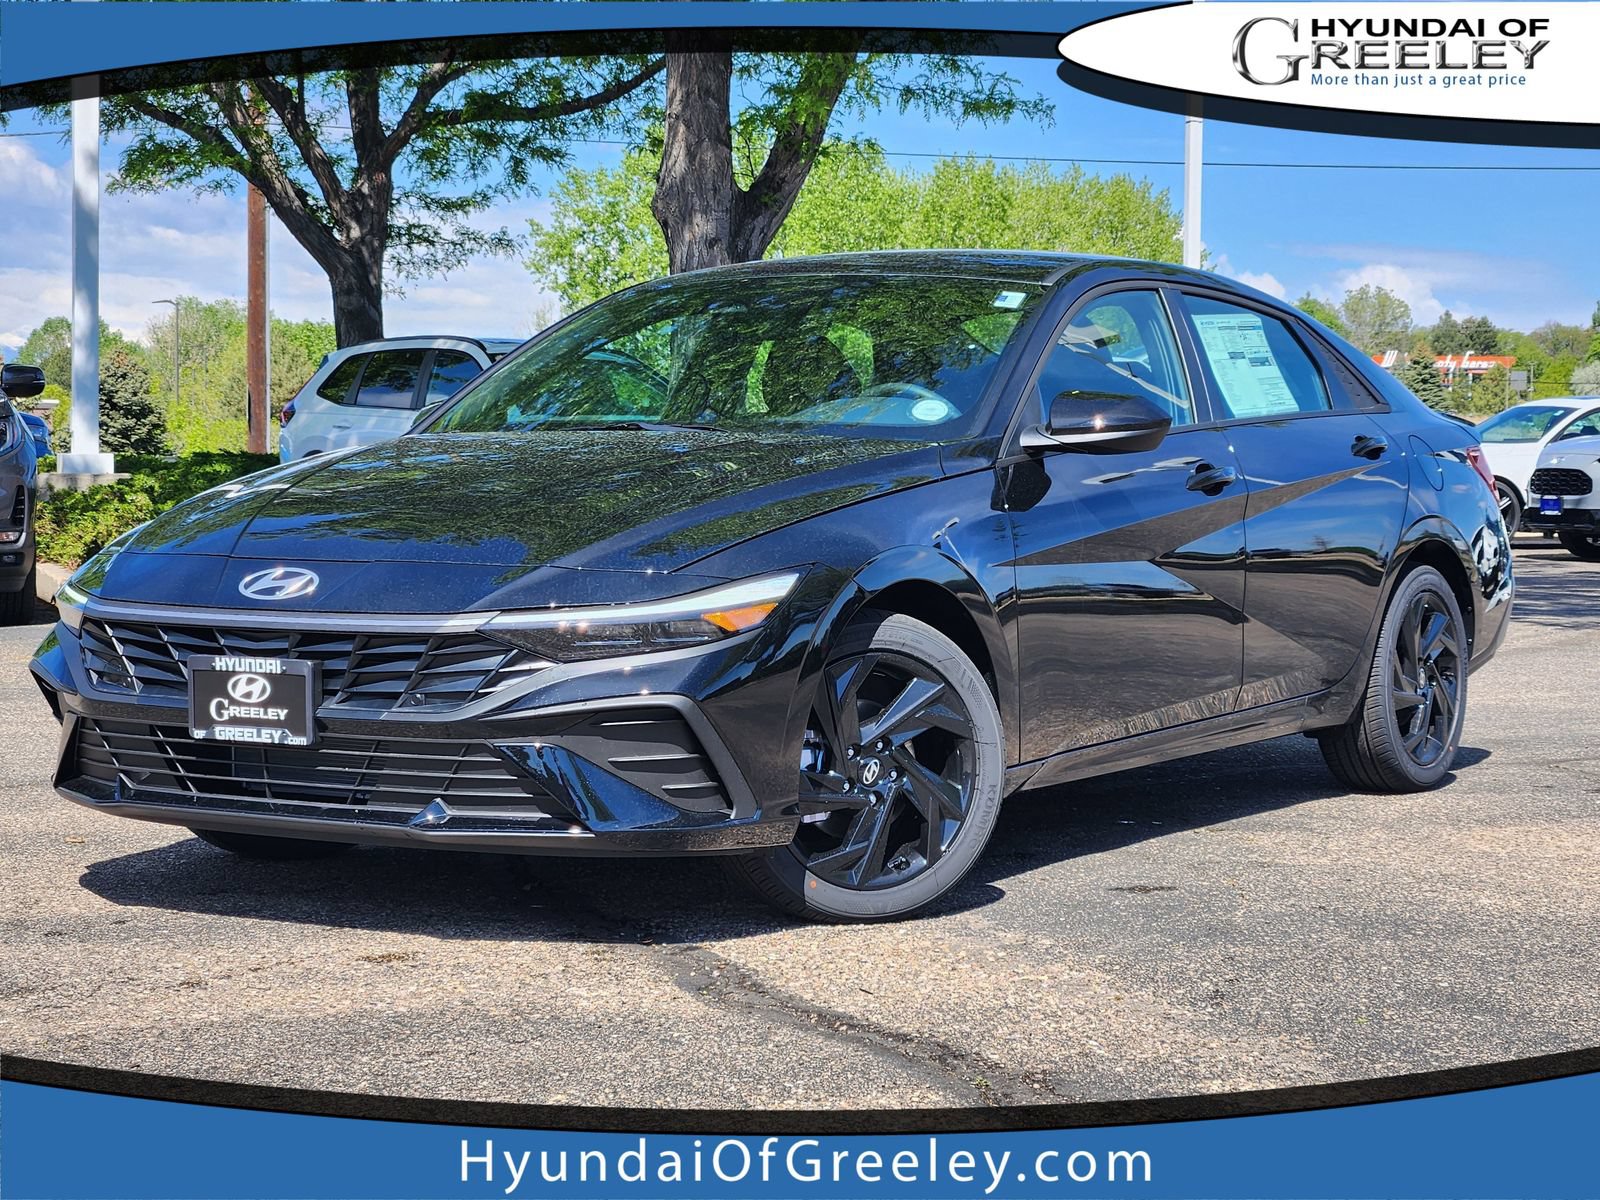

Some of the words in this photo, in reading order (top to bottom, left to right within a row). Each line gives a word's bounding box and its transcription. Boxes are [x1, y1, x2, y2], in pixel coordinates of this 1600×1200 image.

[215, 657, 281, 673] HYUNDAI
[210, 698, 288, 721] GREELEY
[193, 730, 206, 739] OF
[215, 727, 283, 743] GREELEY
